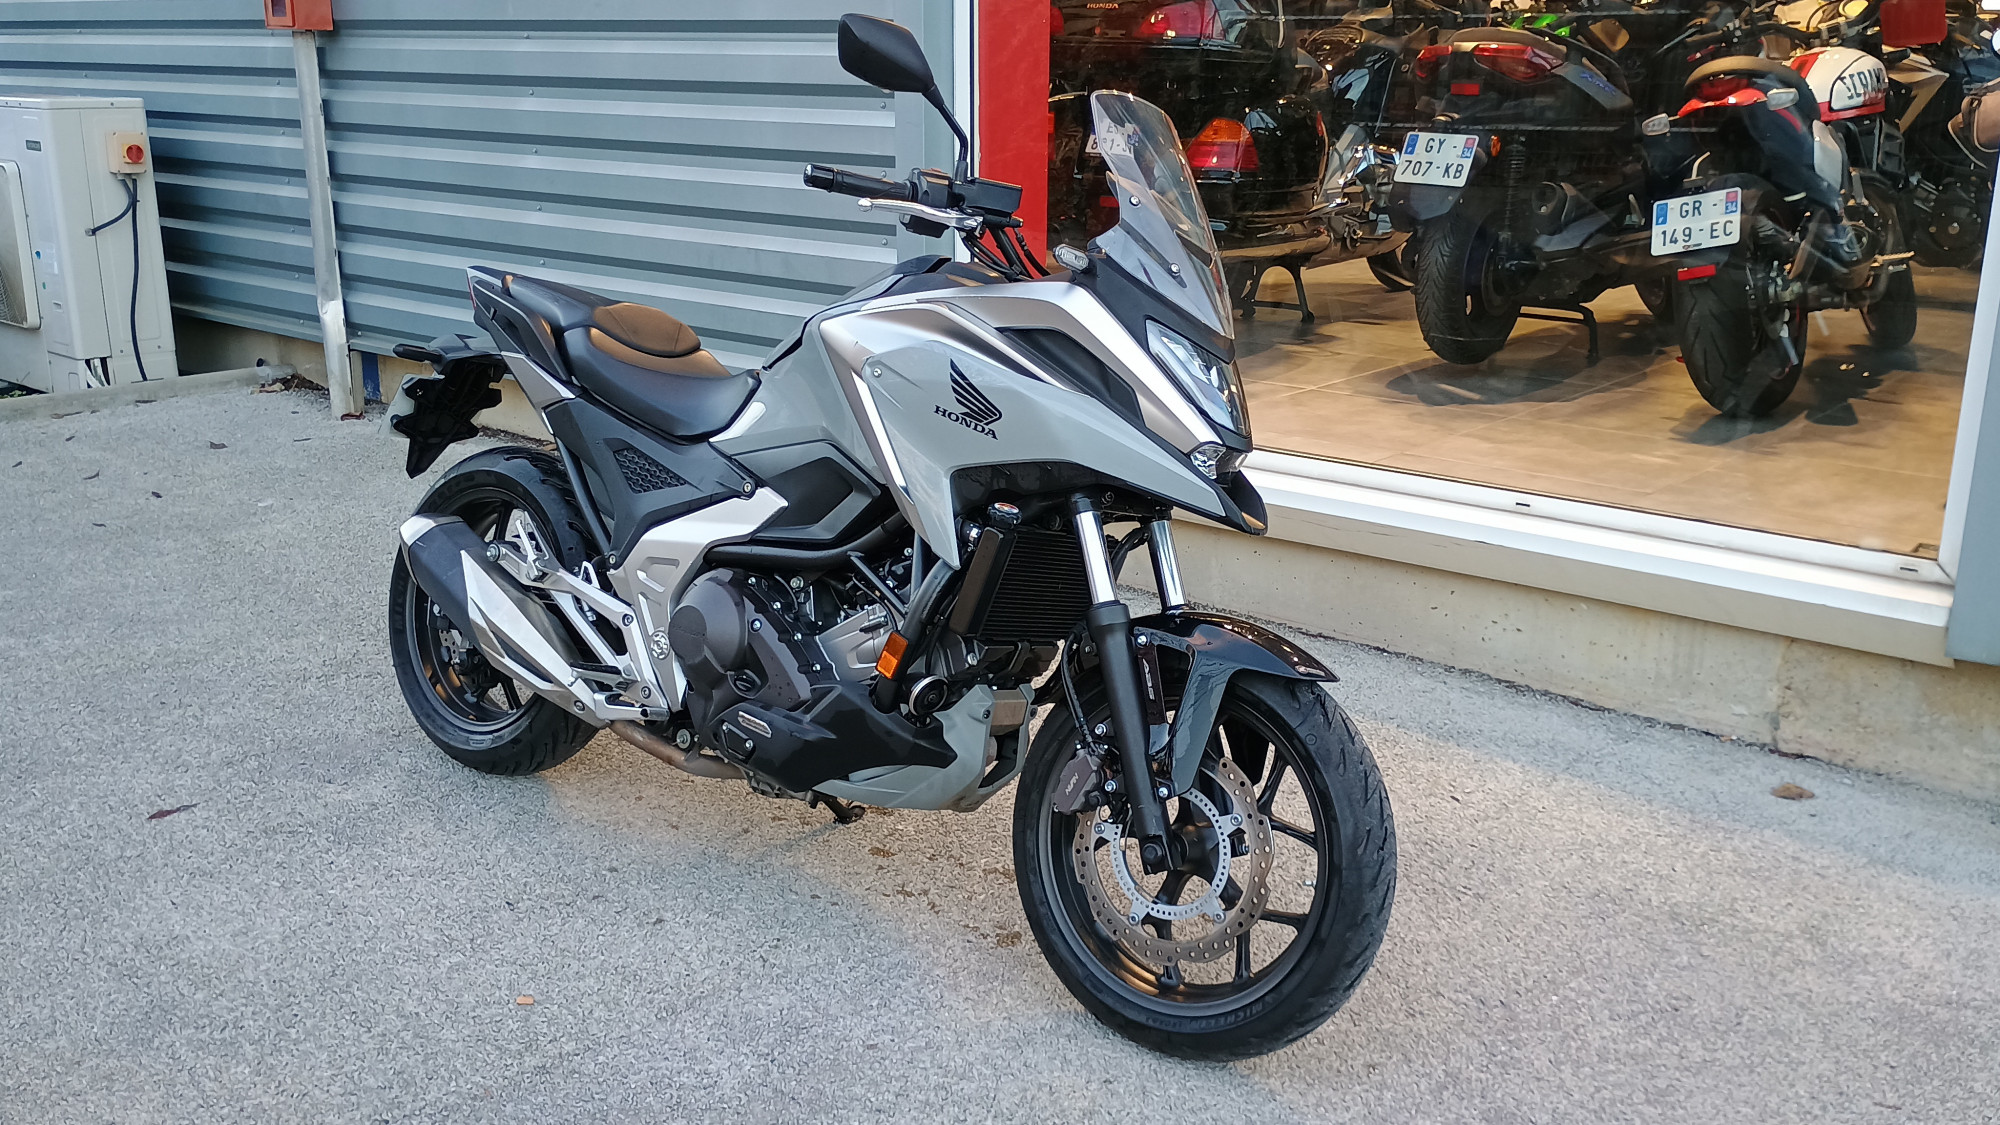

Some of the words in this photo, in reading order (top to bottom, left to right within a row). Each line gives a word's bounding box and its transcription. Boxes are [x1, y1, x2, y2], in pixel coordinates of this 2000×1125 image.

[1461, 148, 1473, 158] 34
[1725, 202, 1737, 213] 34
[934, 405, 999, 441] HONDA
